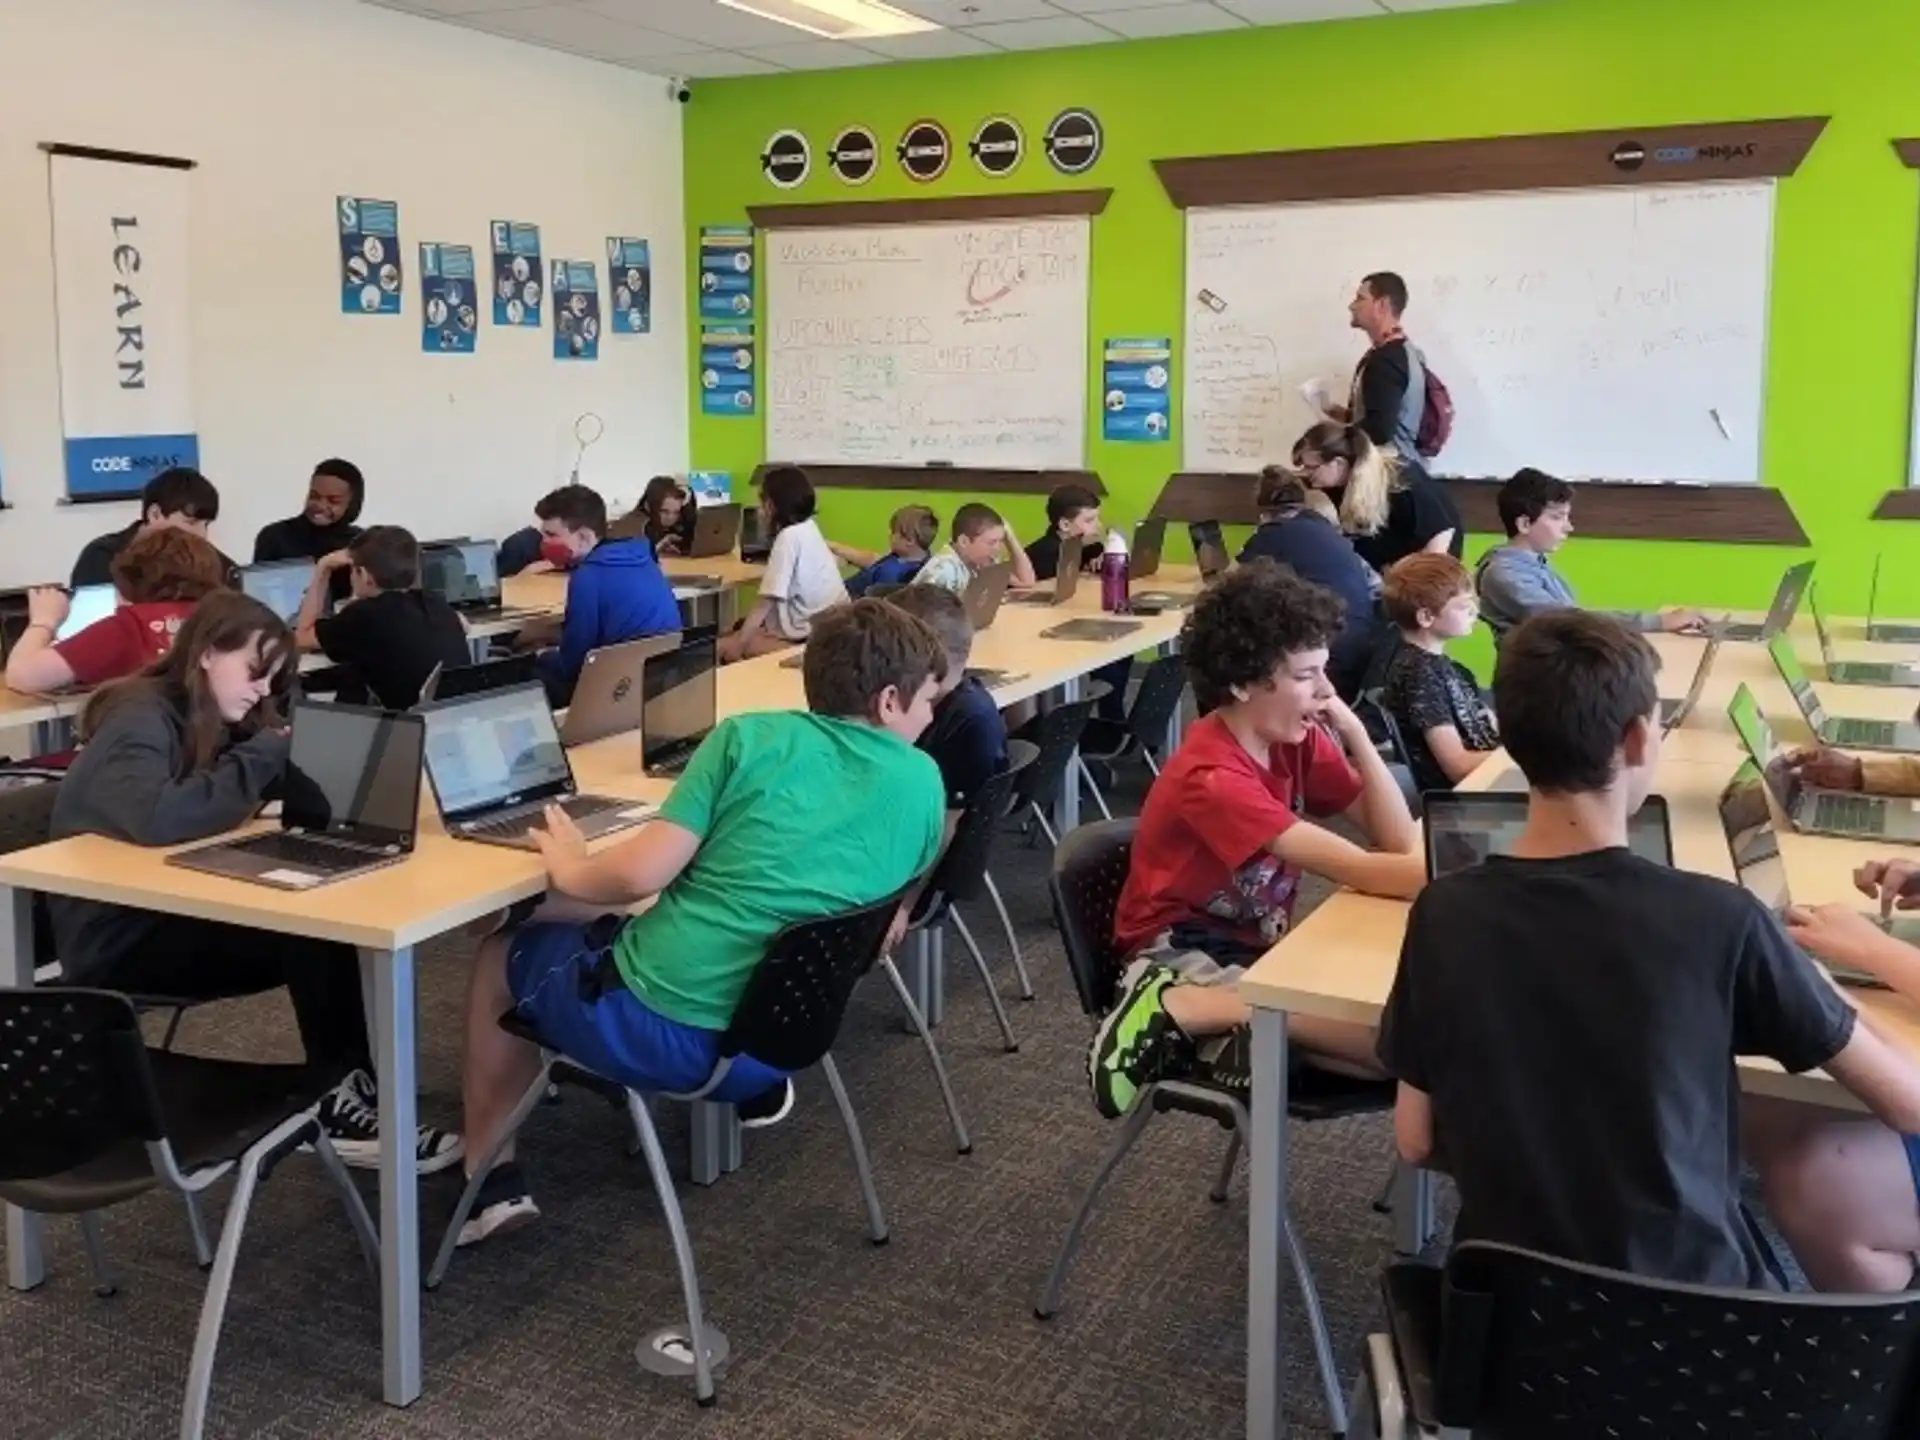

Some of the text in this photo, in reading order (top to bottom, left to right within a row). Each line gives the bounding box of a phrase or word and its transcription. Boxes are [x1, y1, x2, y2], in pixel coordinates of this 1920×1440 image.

[1698, 142, 1757, 160] NINJAS
[341, 198, 357, 226] S
[495, 224, 507, 246] E
[422, 244, 437, 271] T
[554, 264, 567, 287] A
[92, 456, 132, 472] CODE
